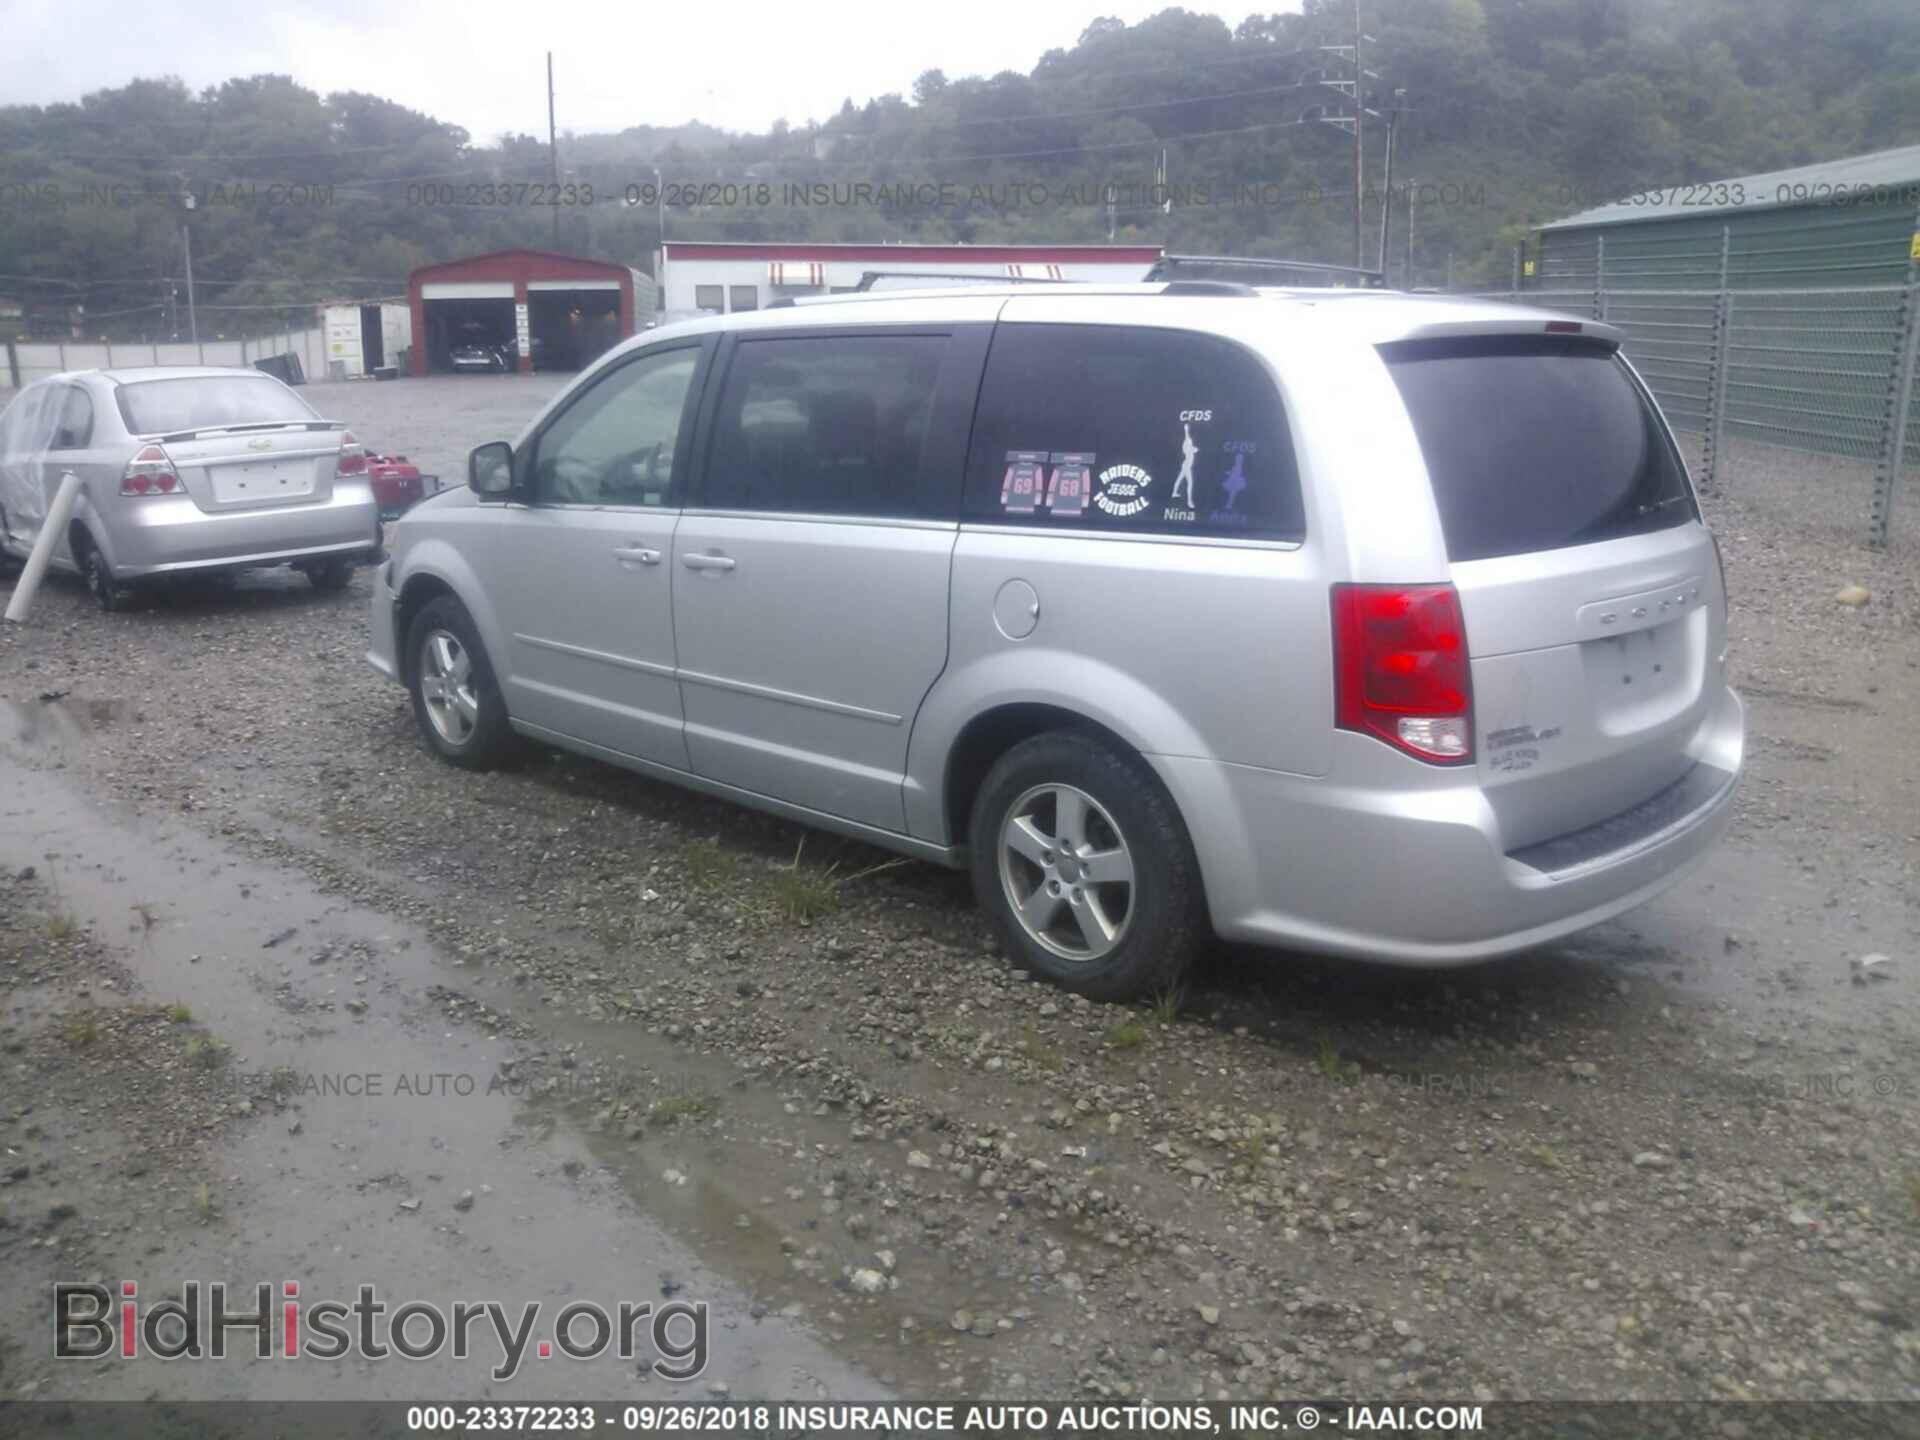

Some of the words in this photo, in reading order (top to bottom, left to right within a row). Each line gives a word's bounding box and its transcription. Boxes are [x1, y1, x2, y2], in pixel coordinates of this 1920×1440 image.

[1179, 410, 1213, 421] CFDS
[1099, 464, 1152, 487] RAIDERS
[1013, 478, 1032, 495] 69
[1093, 492, 1150, 516] FOOTBALL
[1163, 508, 1196, 521] Nina
